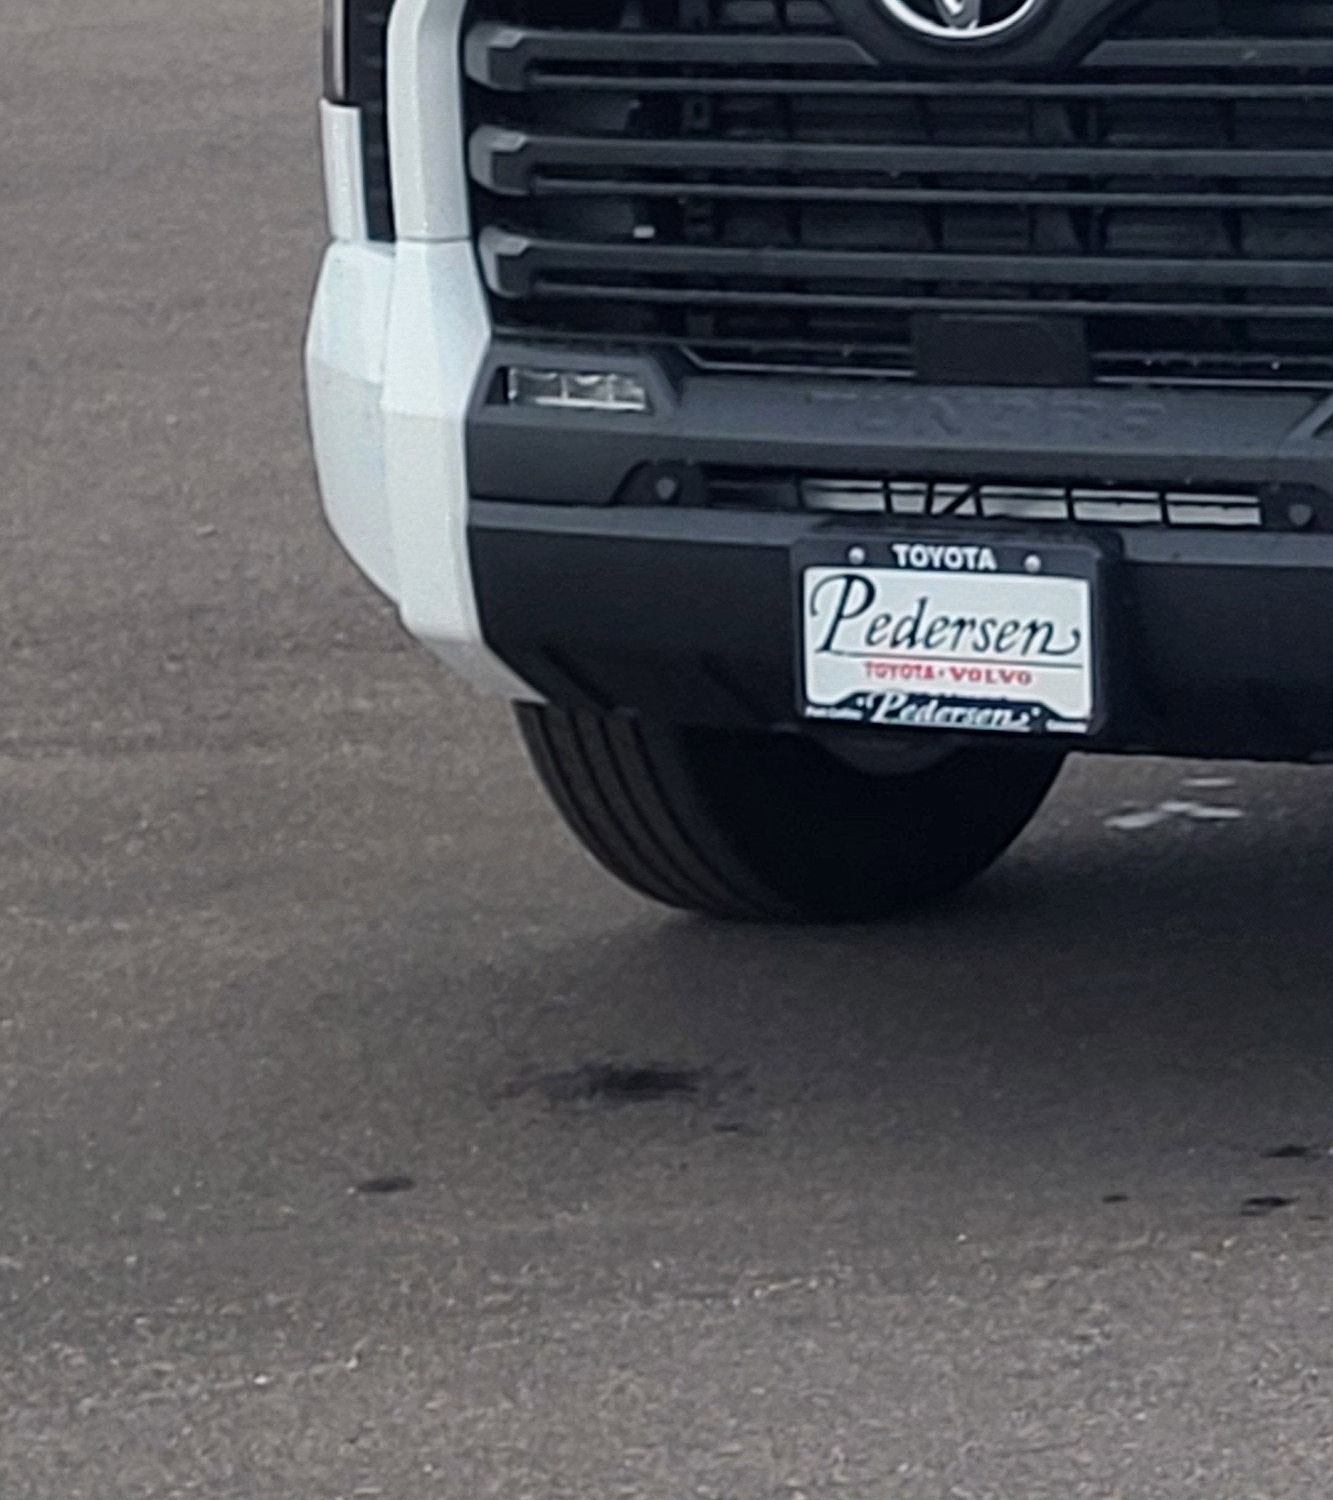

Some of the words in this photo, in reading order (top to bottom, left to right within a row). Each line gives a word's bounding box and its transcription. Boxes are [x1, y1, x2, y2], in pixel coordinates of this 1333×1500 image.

[891, 544, 997, 570] TOYOTA
[810, 573, 1082, 656] Pedersen
[865, 661, 935, 679] TOYOTA
[950, 667, 1032, 685] VOLVO
